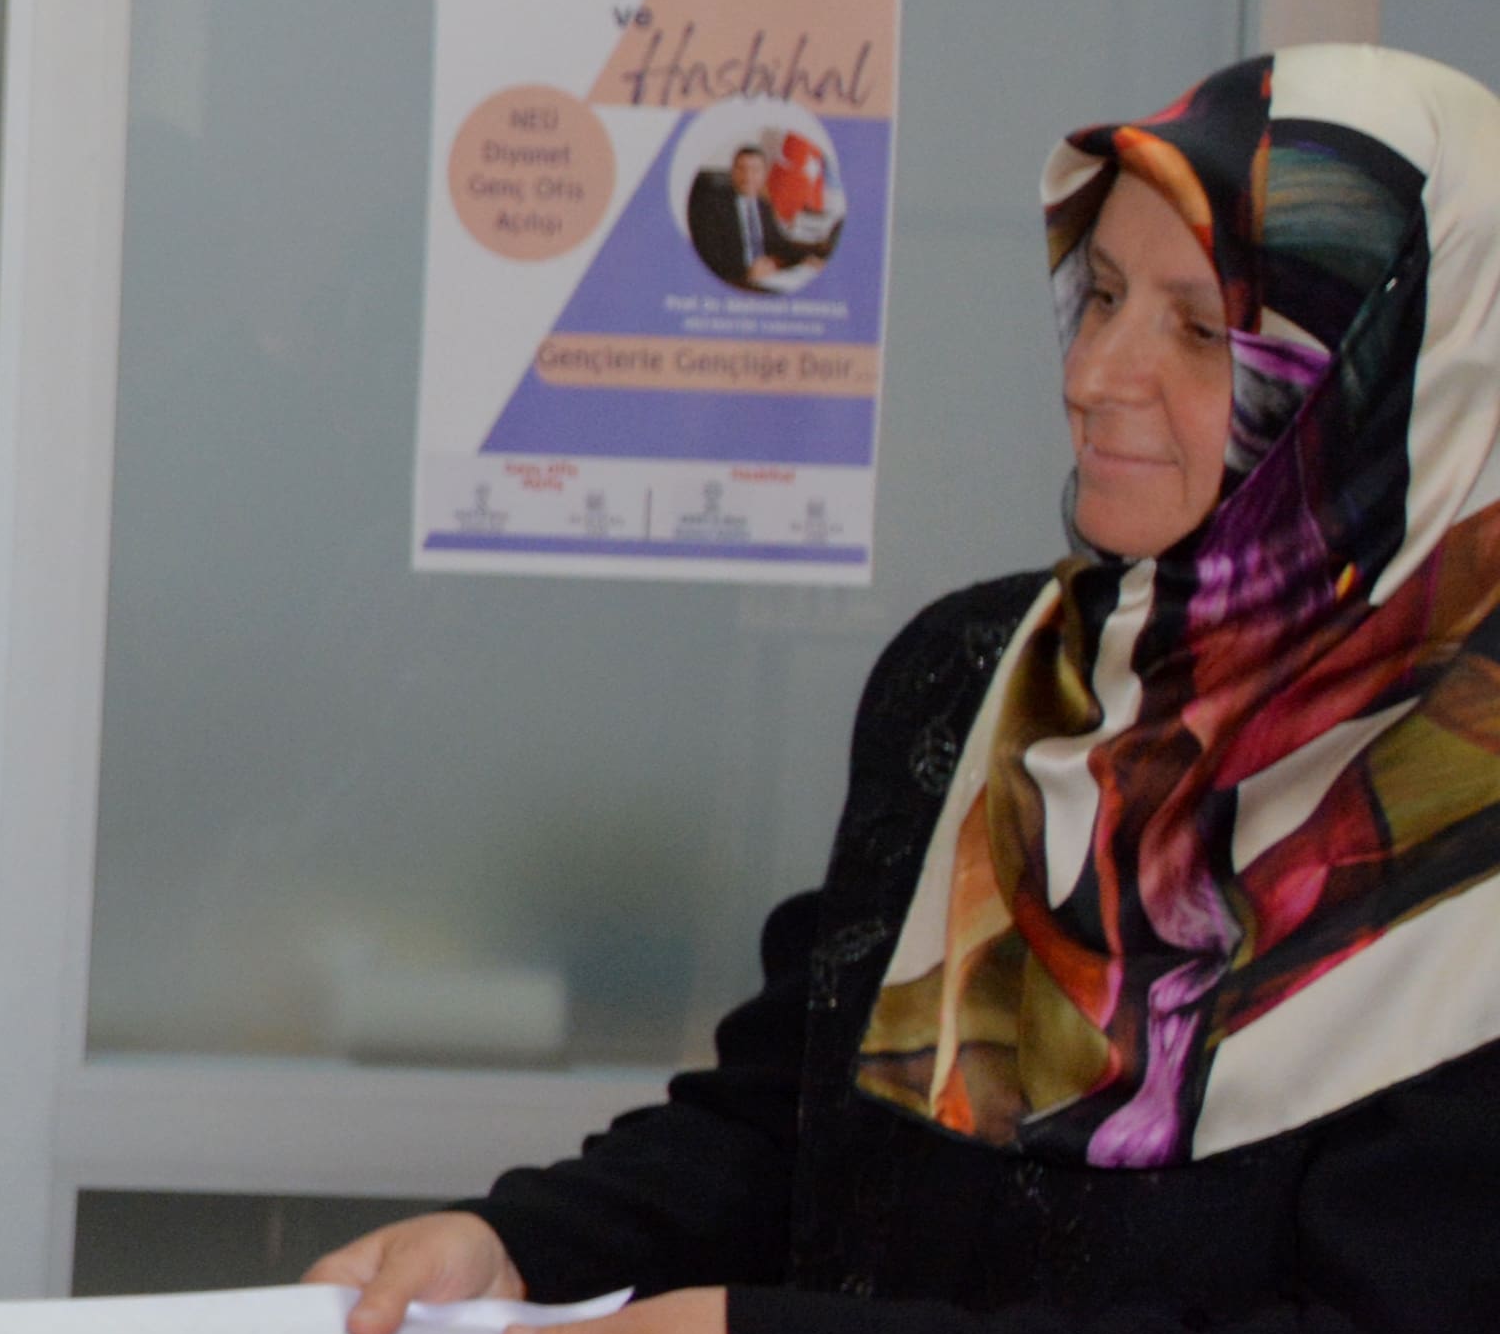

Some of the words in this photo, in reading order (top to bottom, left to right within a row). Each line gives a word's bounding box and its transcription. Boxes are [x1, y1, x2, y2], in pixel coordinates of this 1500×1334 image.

[613, 5, 653, 28] ve
[619, 20, 874, 107] Hasbihal
[482, 139, 571, 168] Diyanet
[468, 173, 524, 203] Genç
[536, 344, 665, 376] Gençlerle
